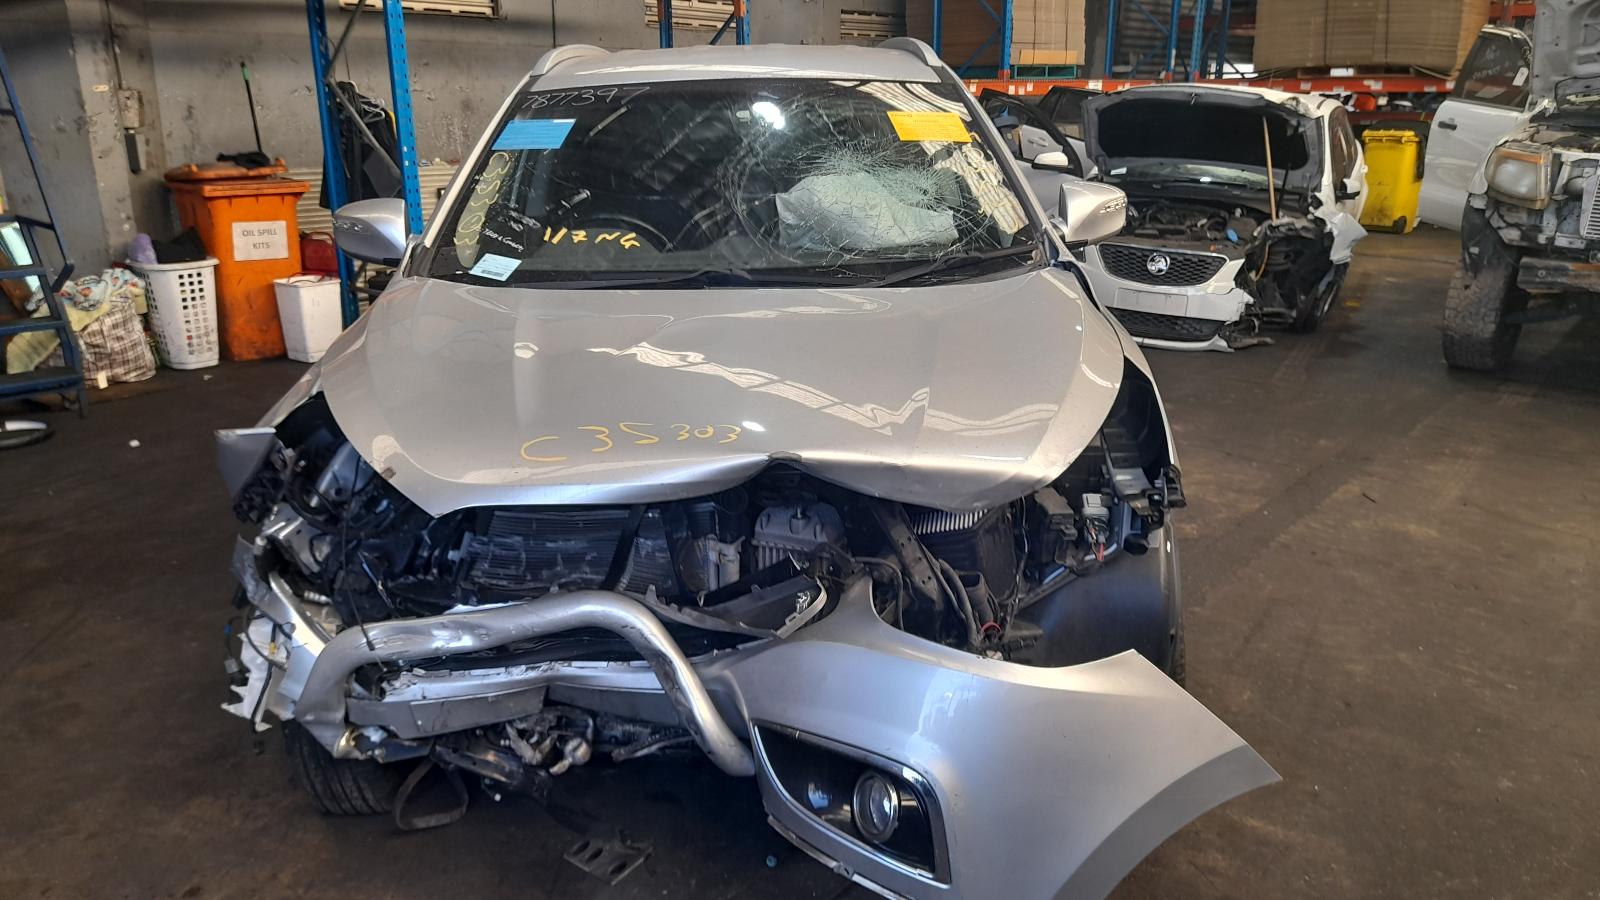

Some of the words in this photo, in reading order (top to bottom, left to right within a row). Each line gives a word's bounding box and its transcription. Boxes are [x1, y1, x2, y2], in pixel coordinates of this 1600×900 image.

[521, 86, 650, 109] 7877397
[241, 229, 256, 237] OIL
[257, 227, 278, 237] SPILL
[252, 241, 271, 250] KITS
